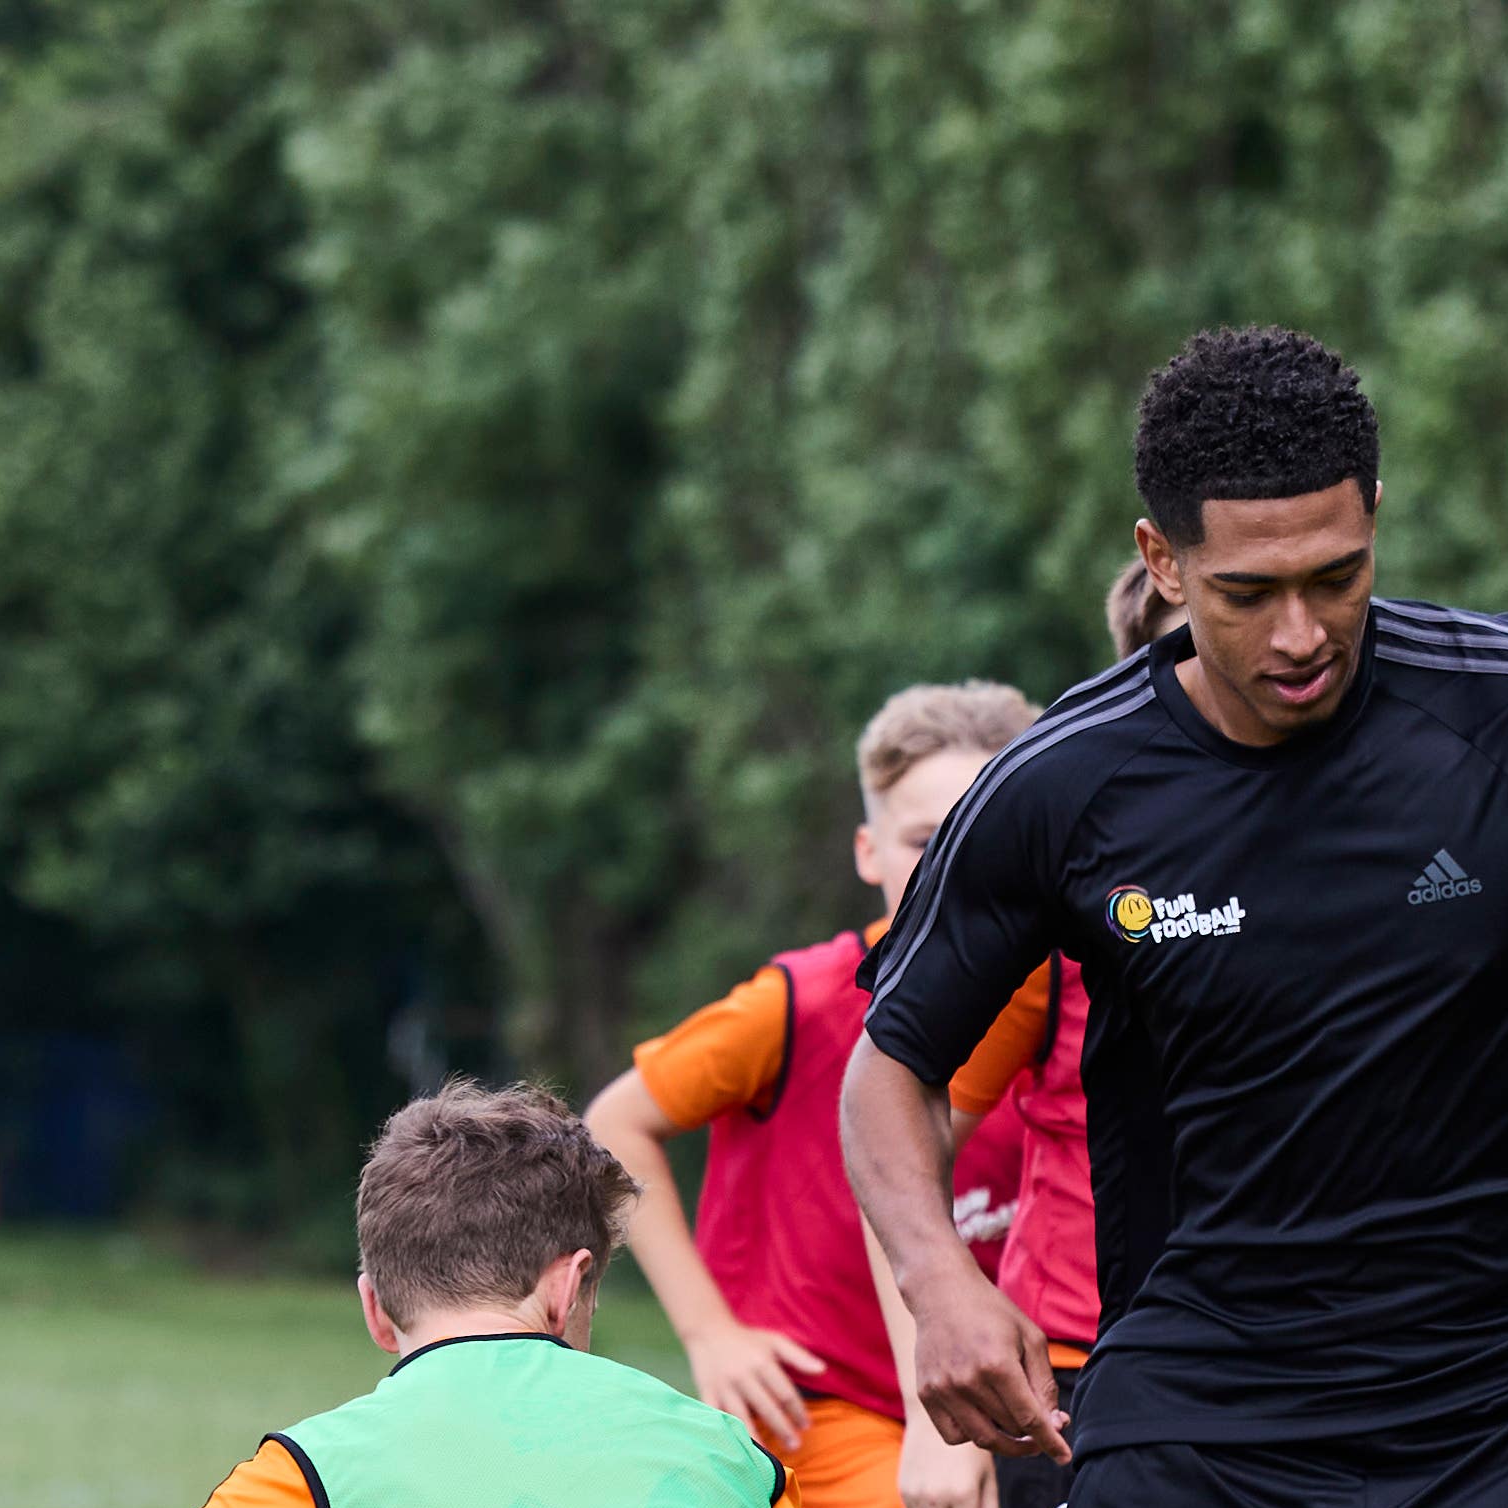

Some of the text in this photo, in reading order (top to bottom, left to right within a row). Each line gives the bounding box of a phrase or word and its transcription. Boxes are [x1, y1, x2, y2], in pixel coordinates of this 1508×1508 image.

[1407, 879, 1483, 905] adidas
[1149, 896, 1246, 944] FOOTBALL
[1152, 893, 1196, 920] FUN
